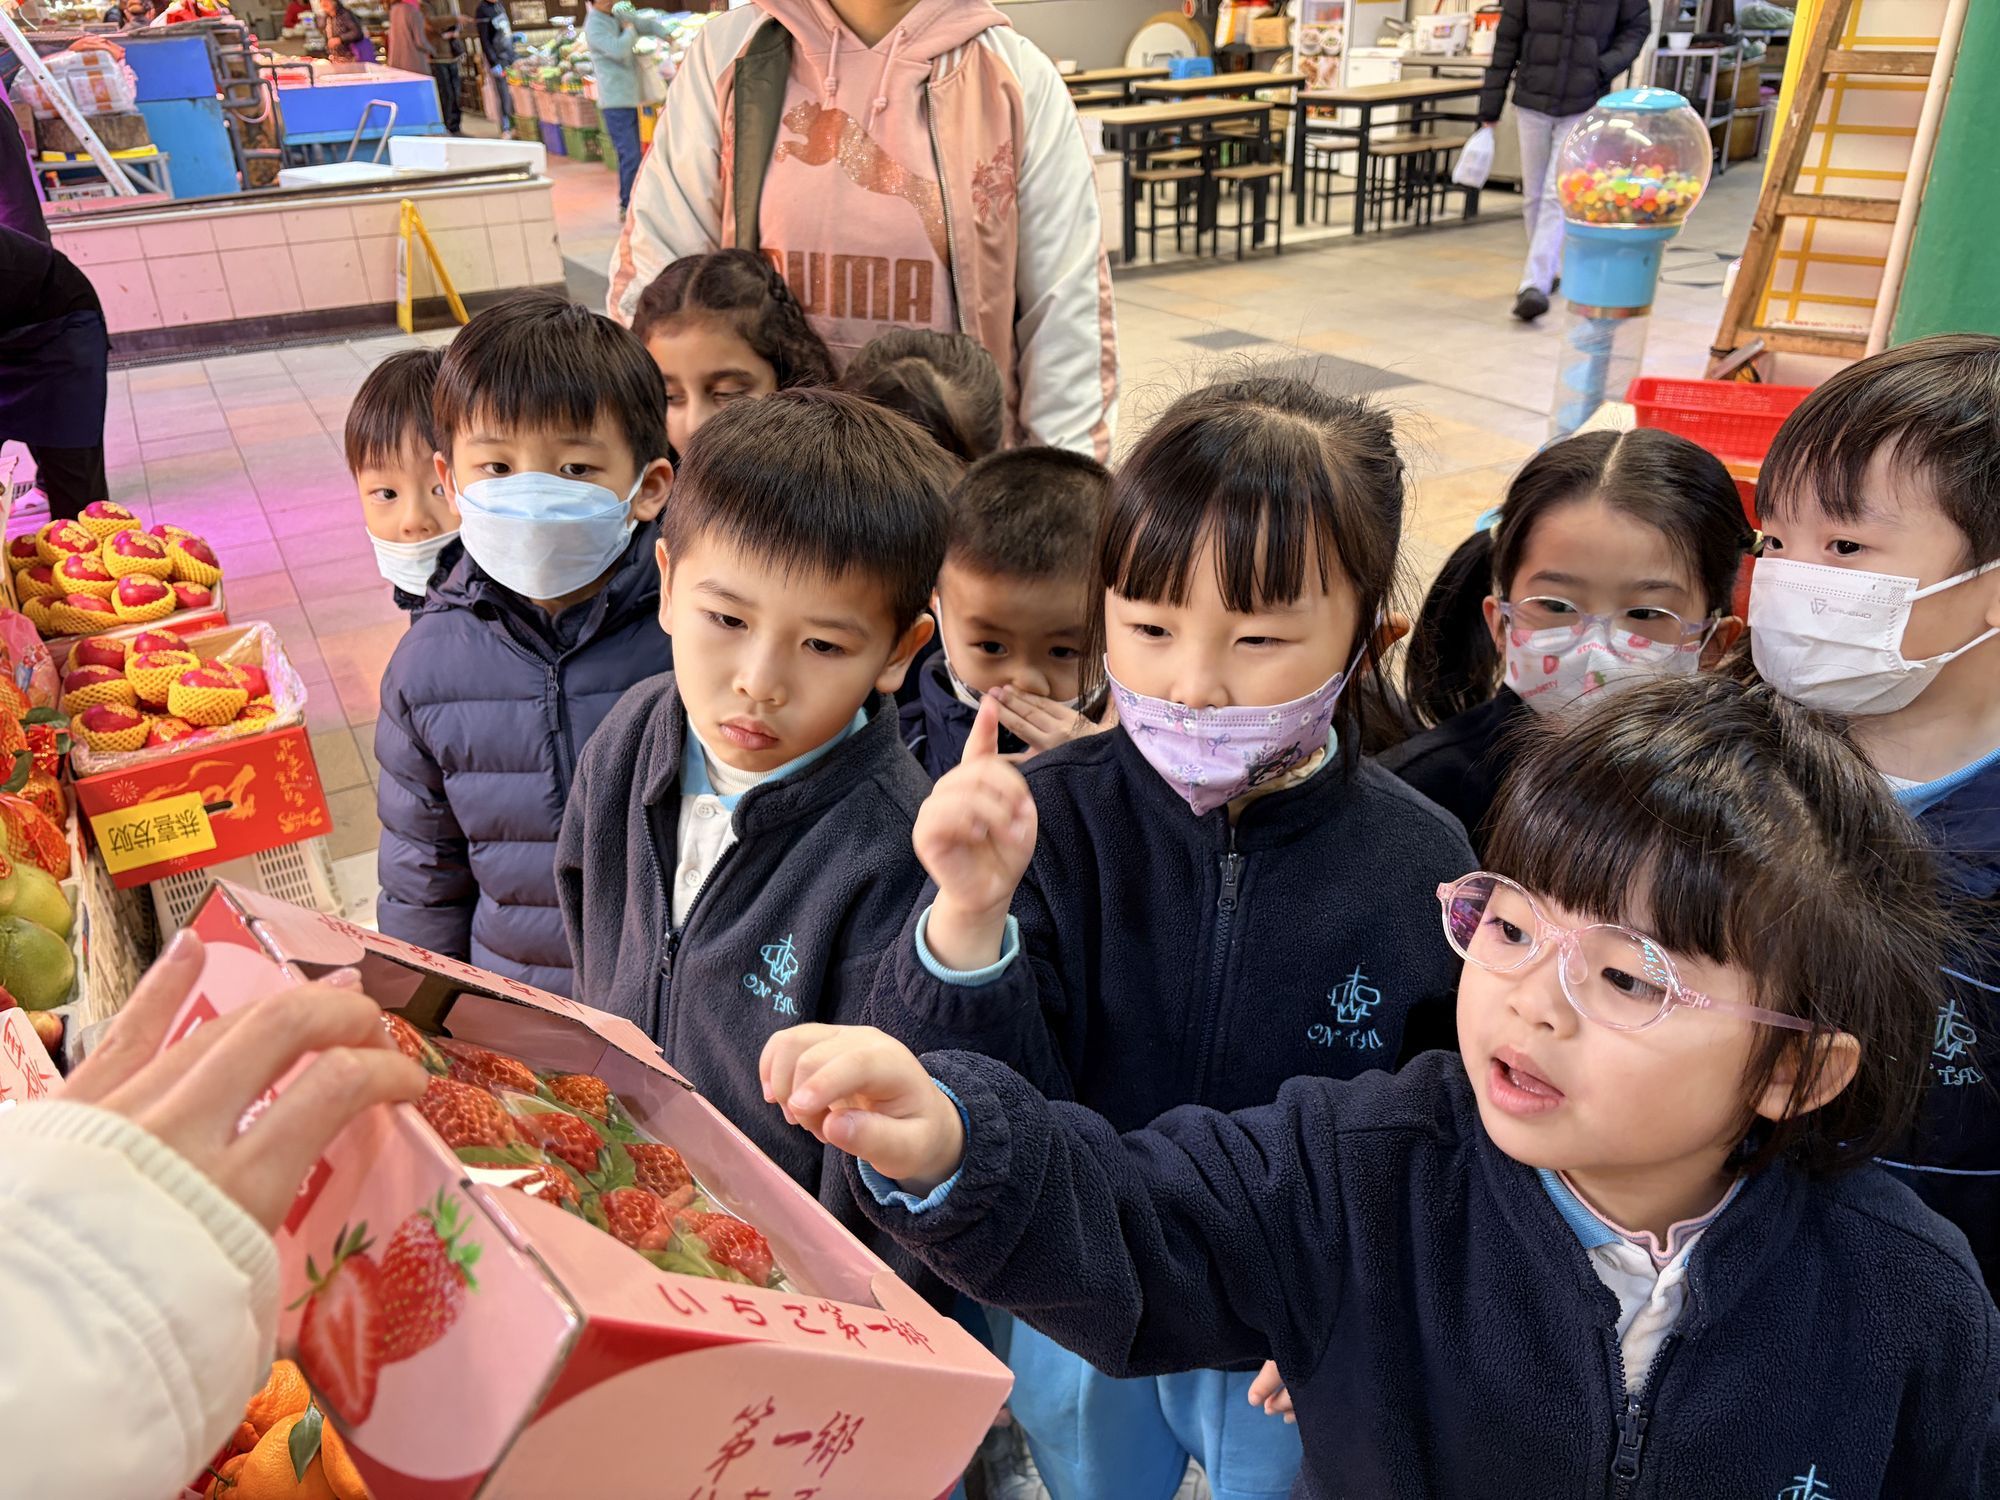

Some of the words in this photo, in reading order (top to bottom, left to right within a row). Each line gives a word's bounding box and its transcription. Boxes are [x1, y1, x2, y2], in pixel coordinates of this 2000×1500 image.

[108, 808, 201, 856] 恭喜发财
[743, 973, 771, 998] ON
[1307, 1023, 1341, 1047] ON
